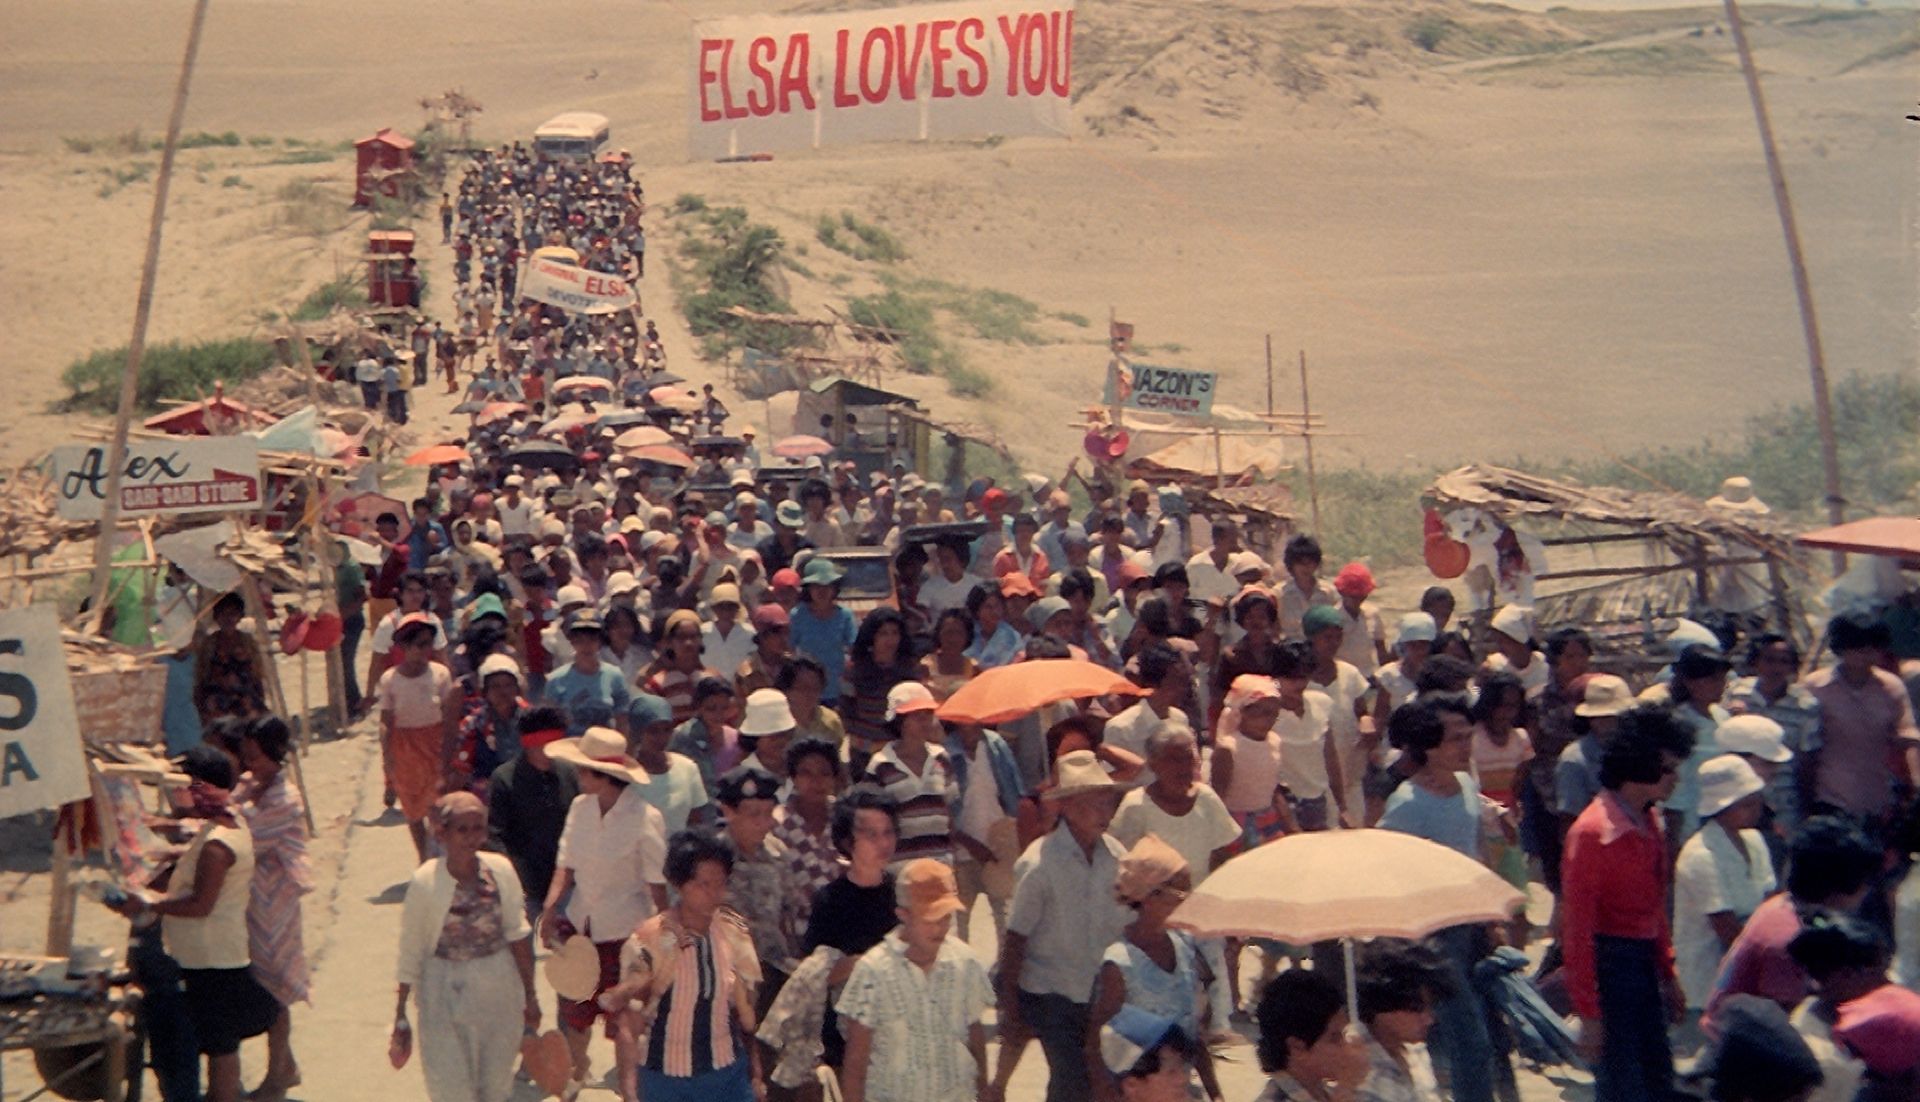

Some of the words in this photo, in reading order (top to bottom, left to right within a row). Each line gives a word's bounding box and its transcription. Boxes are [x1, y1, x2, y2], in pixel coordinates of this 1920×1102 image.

[701, 33, 816, 122] ELSA
[834, 17, 989, 108] LOVES
[998, 10, 1074, 98] YOU
[1136, 392, 1200, 412] CORNER
[199, 480, 250, 503] STORE
